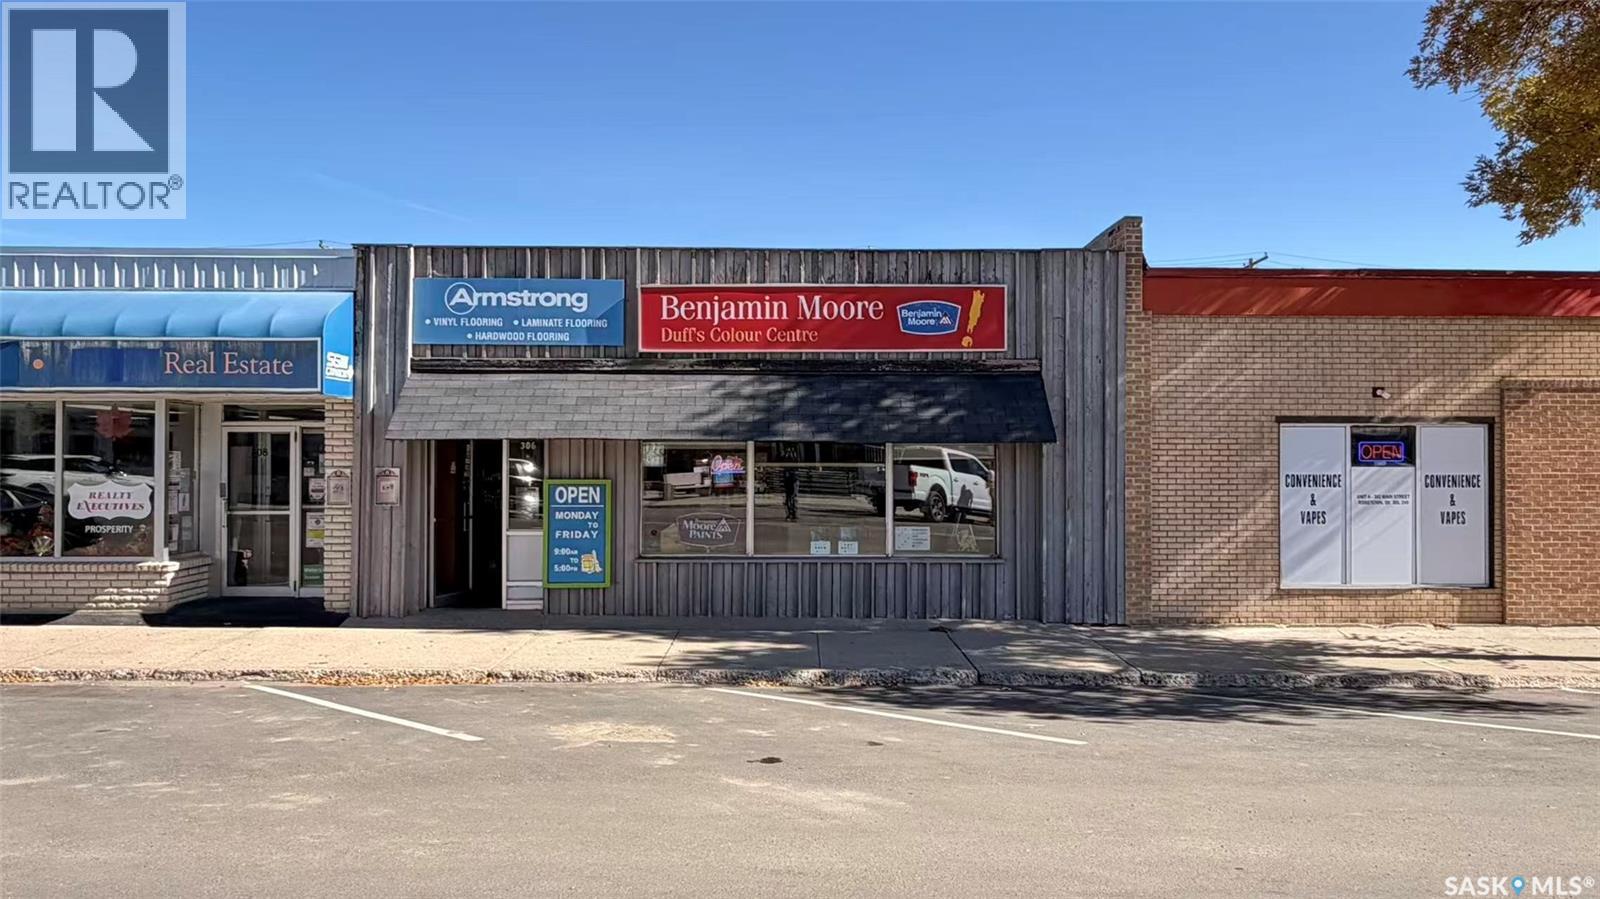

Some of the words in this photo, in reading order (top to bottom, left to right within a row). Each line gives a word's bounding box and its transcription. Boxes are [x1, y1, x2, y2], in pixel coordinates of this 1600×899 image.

[444, 281, 589, 316] Armstrong
[660, 294, 789, 326] Benjamin
[797, 294, 884, 321] Moore
[901, 307, 942, 320] Benjamin
[433, 317, 458, 327] VINYL
[460, 317, 503, 328] FLOORING
[521, 318, 563, 328] LAMINATE
[565, 318, 608, 328] FLOORING
[908, 317, 936, 326] Moore
[475, 331, 525, 341] HARDWOOD
[527, 332, 570, 342] FLOORING
[661, 326, 705, 343] Duff's
[710, 327, 762, 343] Colour
[766, 326, 819, 343] Centre
[164, 350, 216, 375] Real
[222, 350, 294, 376] Estate
[519, 441, 537, 450] 306
[1361, 444, 1403, 460] OPEN
[711, 454, 744, 474] Open
[1285, 473, 1342, 488] CONVENIENCE
[1424, 474, 1481, 489] CONVENIENCE
[88, 491, 133, 500] REALTY
[555, 486, 600, 504] OPEN
[1310, 493, 1317, 506] &
[1449, 493, 1456, 506] &
[77, 500, 145, 513] EXECUTIVES
[555, 511, 599, 520] MONDAY
[1300, 510, 1327, 525] VAPES
[1440, 510, 1466, 525] VAPES
[85, 525, 134, 534] PROSPERITY
[682, 519, 717, 531] Moore
[555, 530, 599, 539] FRIDAY
[688, 530, 724, 539] PAINTS
